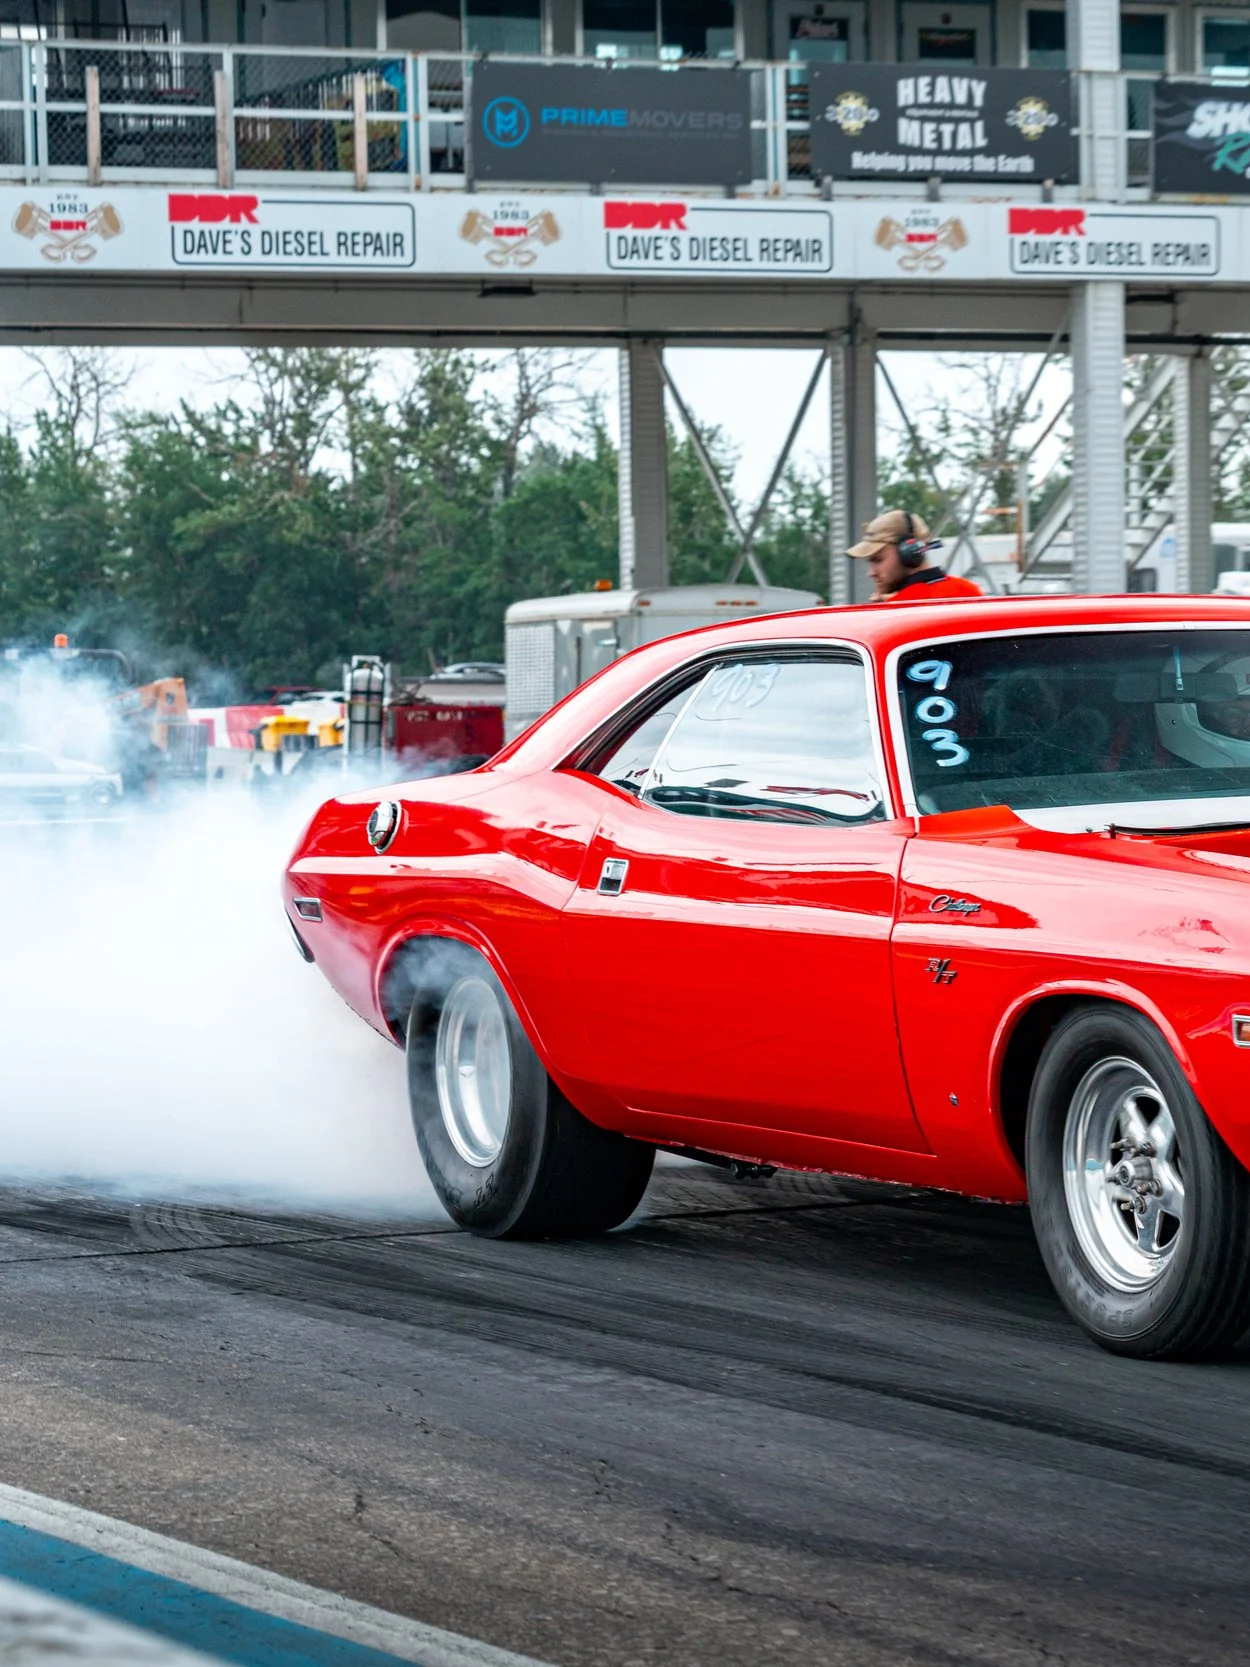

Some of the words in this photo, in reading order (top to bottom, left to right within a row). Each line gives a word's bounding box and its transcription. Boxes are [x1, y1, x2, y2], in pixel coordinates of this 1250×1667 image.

[897, 75, 987, 108] HEAVY
[541, 107, 743, 130] PRIMEMOVERS
[897, 117, 988, 150] METAL
[851, 151, 906, 173] Helping
[907, 156, 933, 173] you
[934, 156, 971, 172] move
[973, 153, 996, 172] the
[997, 154, 1034, 173] Earth
[50, 202, 88, 213] 1983
[168, 194, 260, 223] DDR
[493, 210, 530, 220] 1983
[604, 201, 688, 230] DDR
[183, 229, 252, 255] DAVE'S
[261, 230, 330, 257] DIESEL
[336, 231, 405, 258] REPAIR
[617, 235, 681, 261] DAVE'S
[689, 236, 752, 263] DIESEL
[759, 238, 823, 263] REPAIR
[1020, 240, 1080, 265] DAVE'S
[1087, 241, 1145, 266] DIESEL
[1151, 243, 1212, 267] REPAIR
[710, 663, 780, 712] 903
[906, 660, 970, 767] 903
[925, 957, 957, 984] R/T
